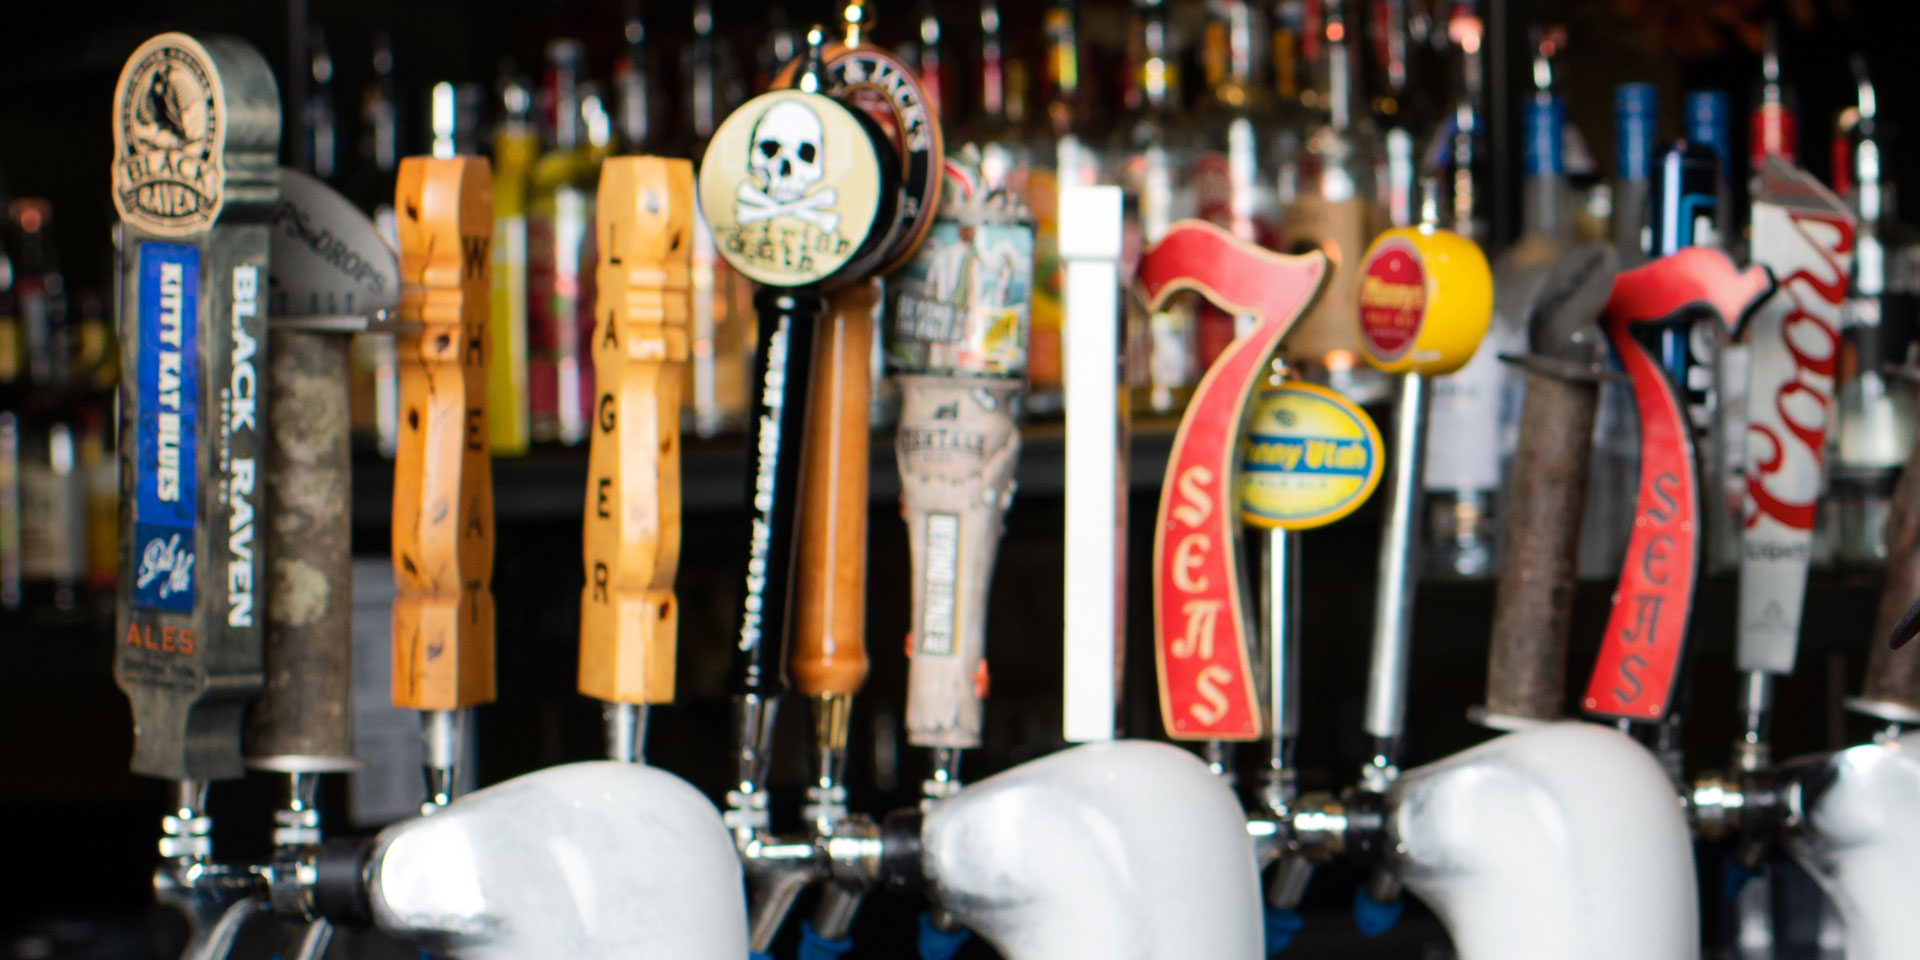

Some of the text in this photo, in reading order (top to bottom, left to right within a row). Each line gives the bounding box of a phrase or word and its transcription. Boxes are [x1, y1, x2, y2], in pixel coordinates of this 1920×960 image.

[126, 155, 213, 191] BLACK
[138, 182, 199, 216] RAVEN
[311, 229, 387, 294] DROPS
[157, 262, 183, 502] KITTY KAT BLUES
[229, 265, 258, 627] BLACK RAVEN
[462, 235, 488, 625] WHEAT
[592, 223, 621, 604] LAGER
[1744, 208, 1855, 534] Coors
[1304, 438, 1367, 470] Utah
[125, 620, 195, 655] ALES
